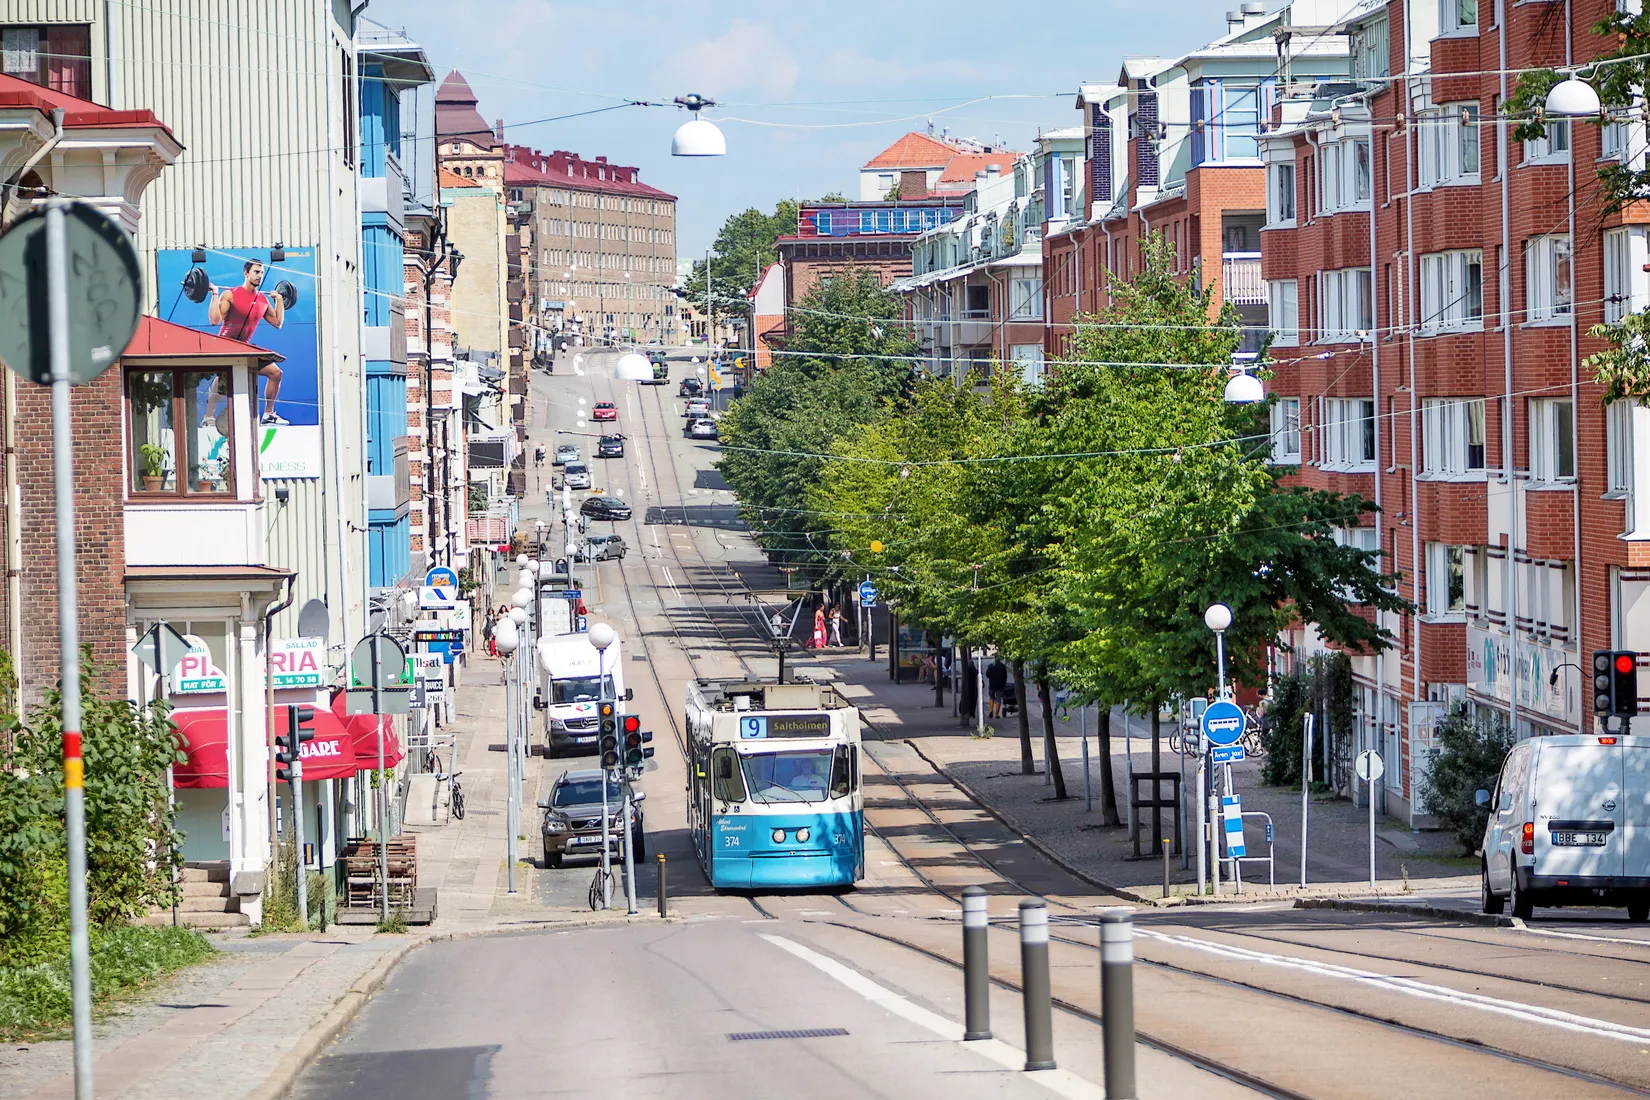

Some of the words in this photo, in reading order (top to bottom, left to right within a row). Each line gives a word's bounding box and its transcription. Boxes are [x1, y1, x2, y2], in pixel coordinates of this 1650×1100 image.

[261, 461, 307, 472] LNESS
[201, 679, 216, 688] FÖR
[426, 681, 442, 690] RVICE
[749, 718, 760, 737] 9
[773, 721, 828, 731] Saltholmen
[725, 836, 740, 846] 374
[834, 834, 846, 845] 374
[1559, 833, 1578, 842] BBE
[1585, 833, 1603, 843] 134
